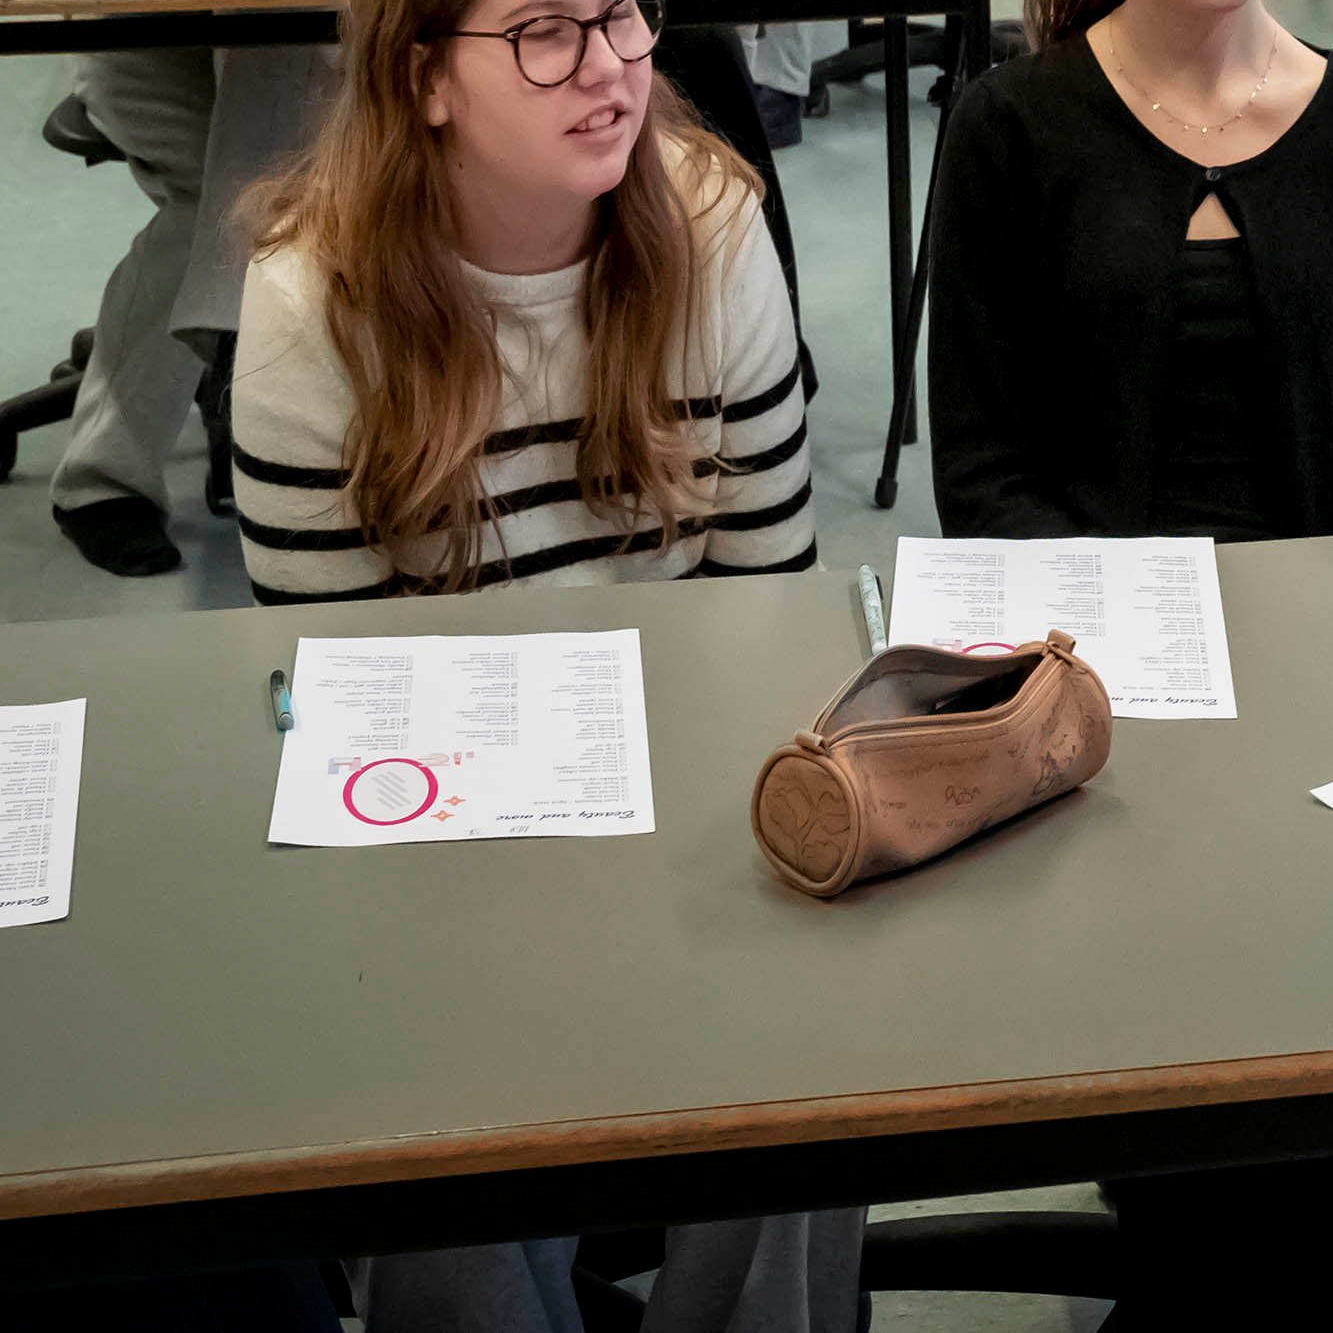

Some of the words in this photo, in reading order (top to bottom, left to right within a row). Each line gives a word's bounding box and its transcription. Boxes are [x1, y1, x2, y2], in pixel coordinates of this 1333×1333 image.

[1164, 696, 1218, 706] Beauty
[496, 813, 534, 821] more
[539, 812, 571, 821] and
[578, 809, 635, 819] Beauty
